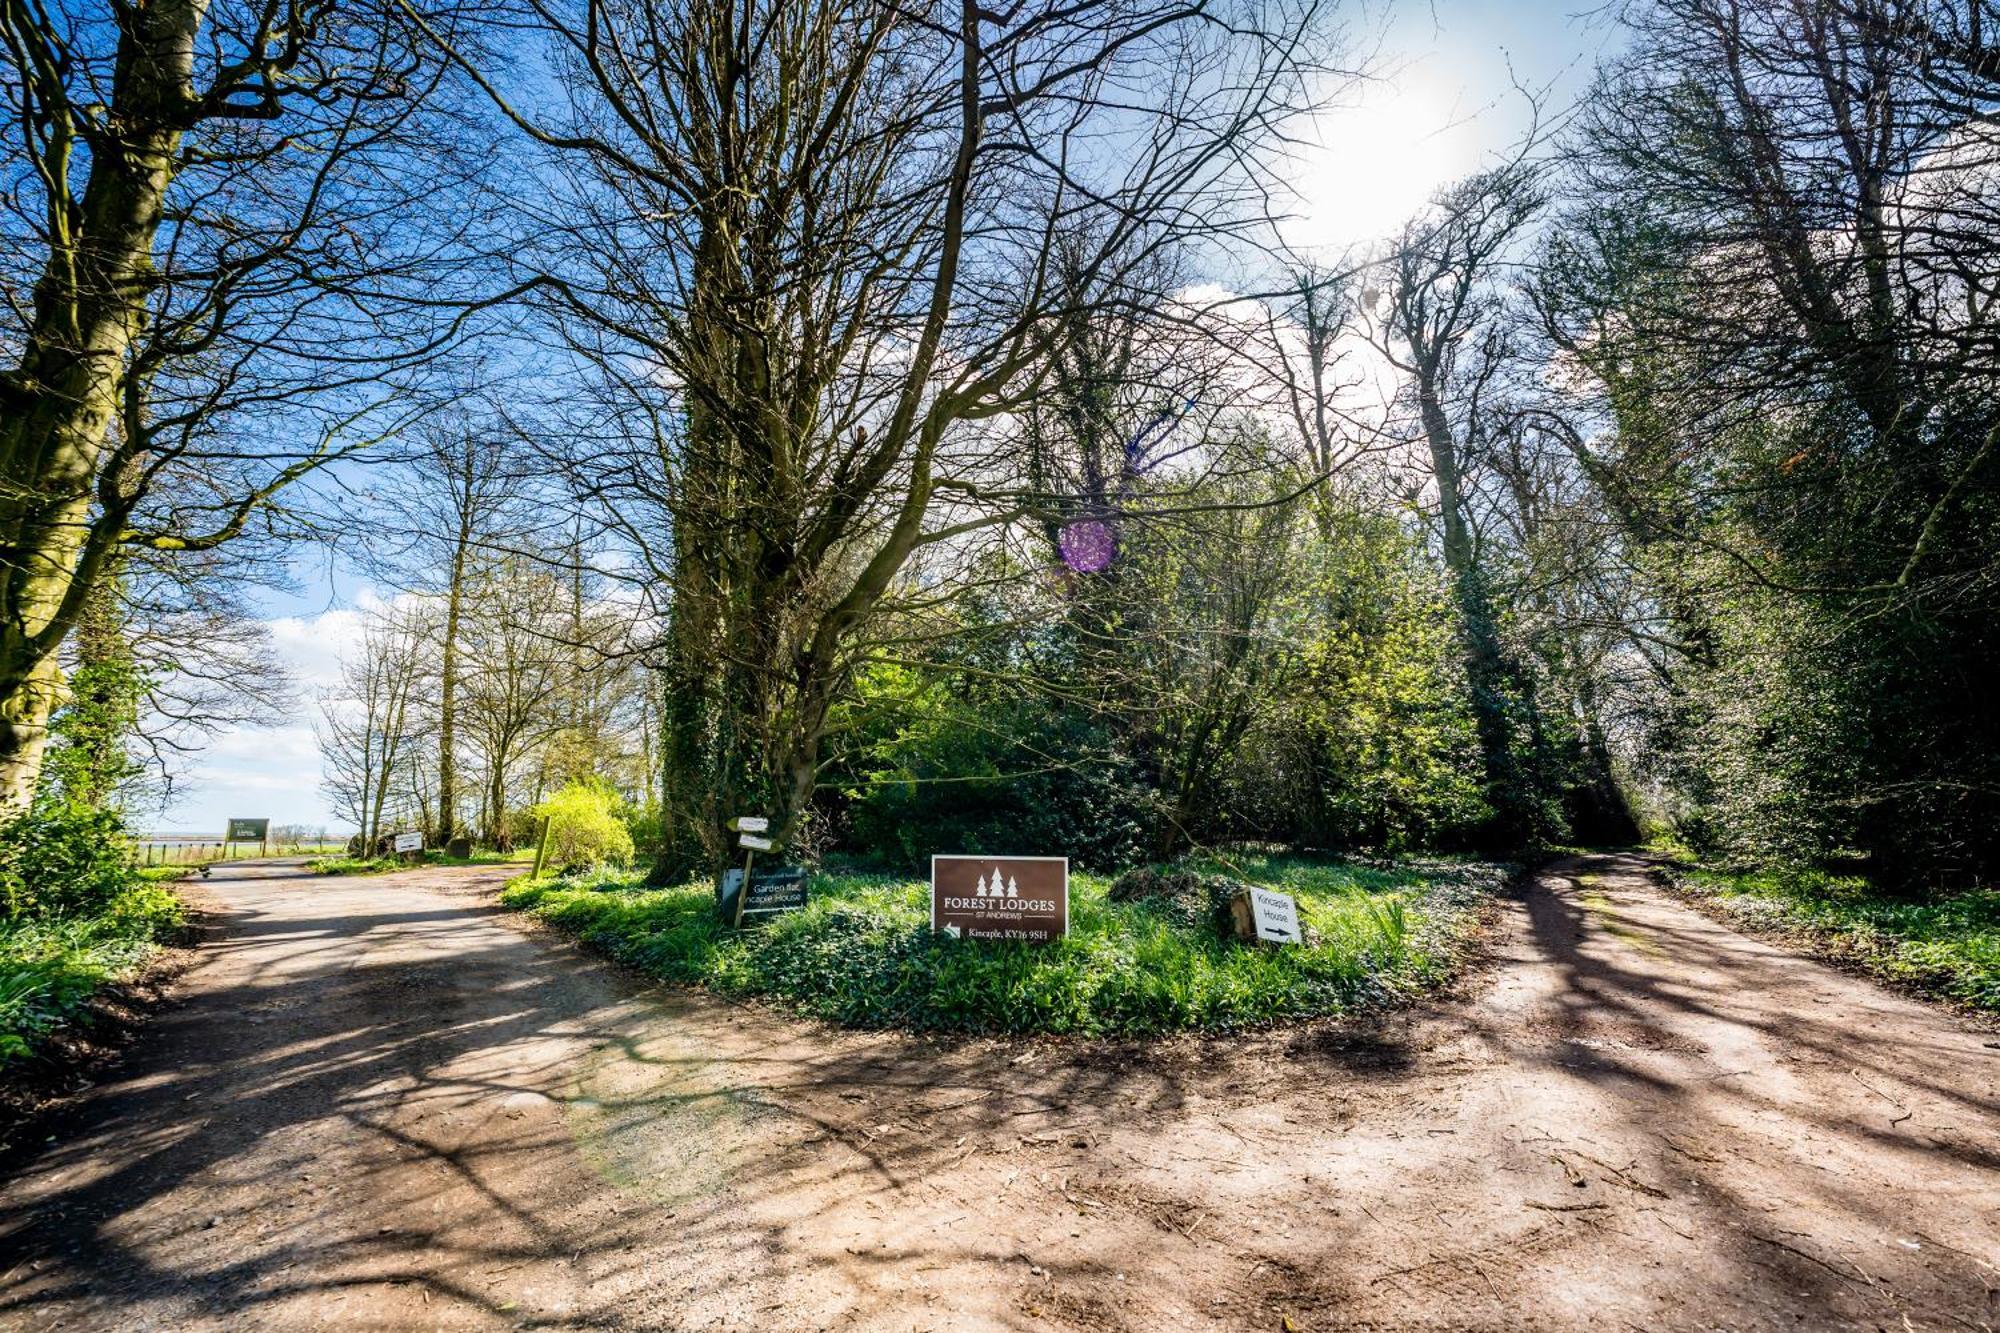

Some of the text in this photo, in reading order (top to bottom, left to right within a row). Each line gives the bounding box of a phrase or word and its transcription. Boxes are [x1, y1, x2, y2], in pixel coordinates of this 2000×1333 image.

[753, 884, 785, 893] Garden
[775, 893, 801, 901] House
[1256, 893, 1289, 909] Kincaple
[944, 897, 1056, 912] FOREST LODGES
[986, 911, 1022, 920] ANDREWS
[1263, 908, 1288, 922] House
[968, 928, 1048, 939] Kincaple, KY16 9SH
